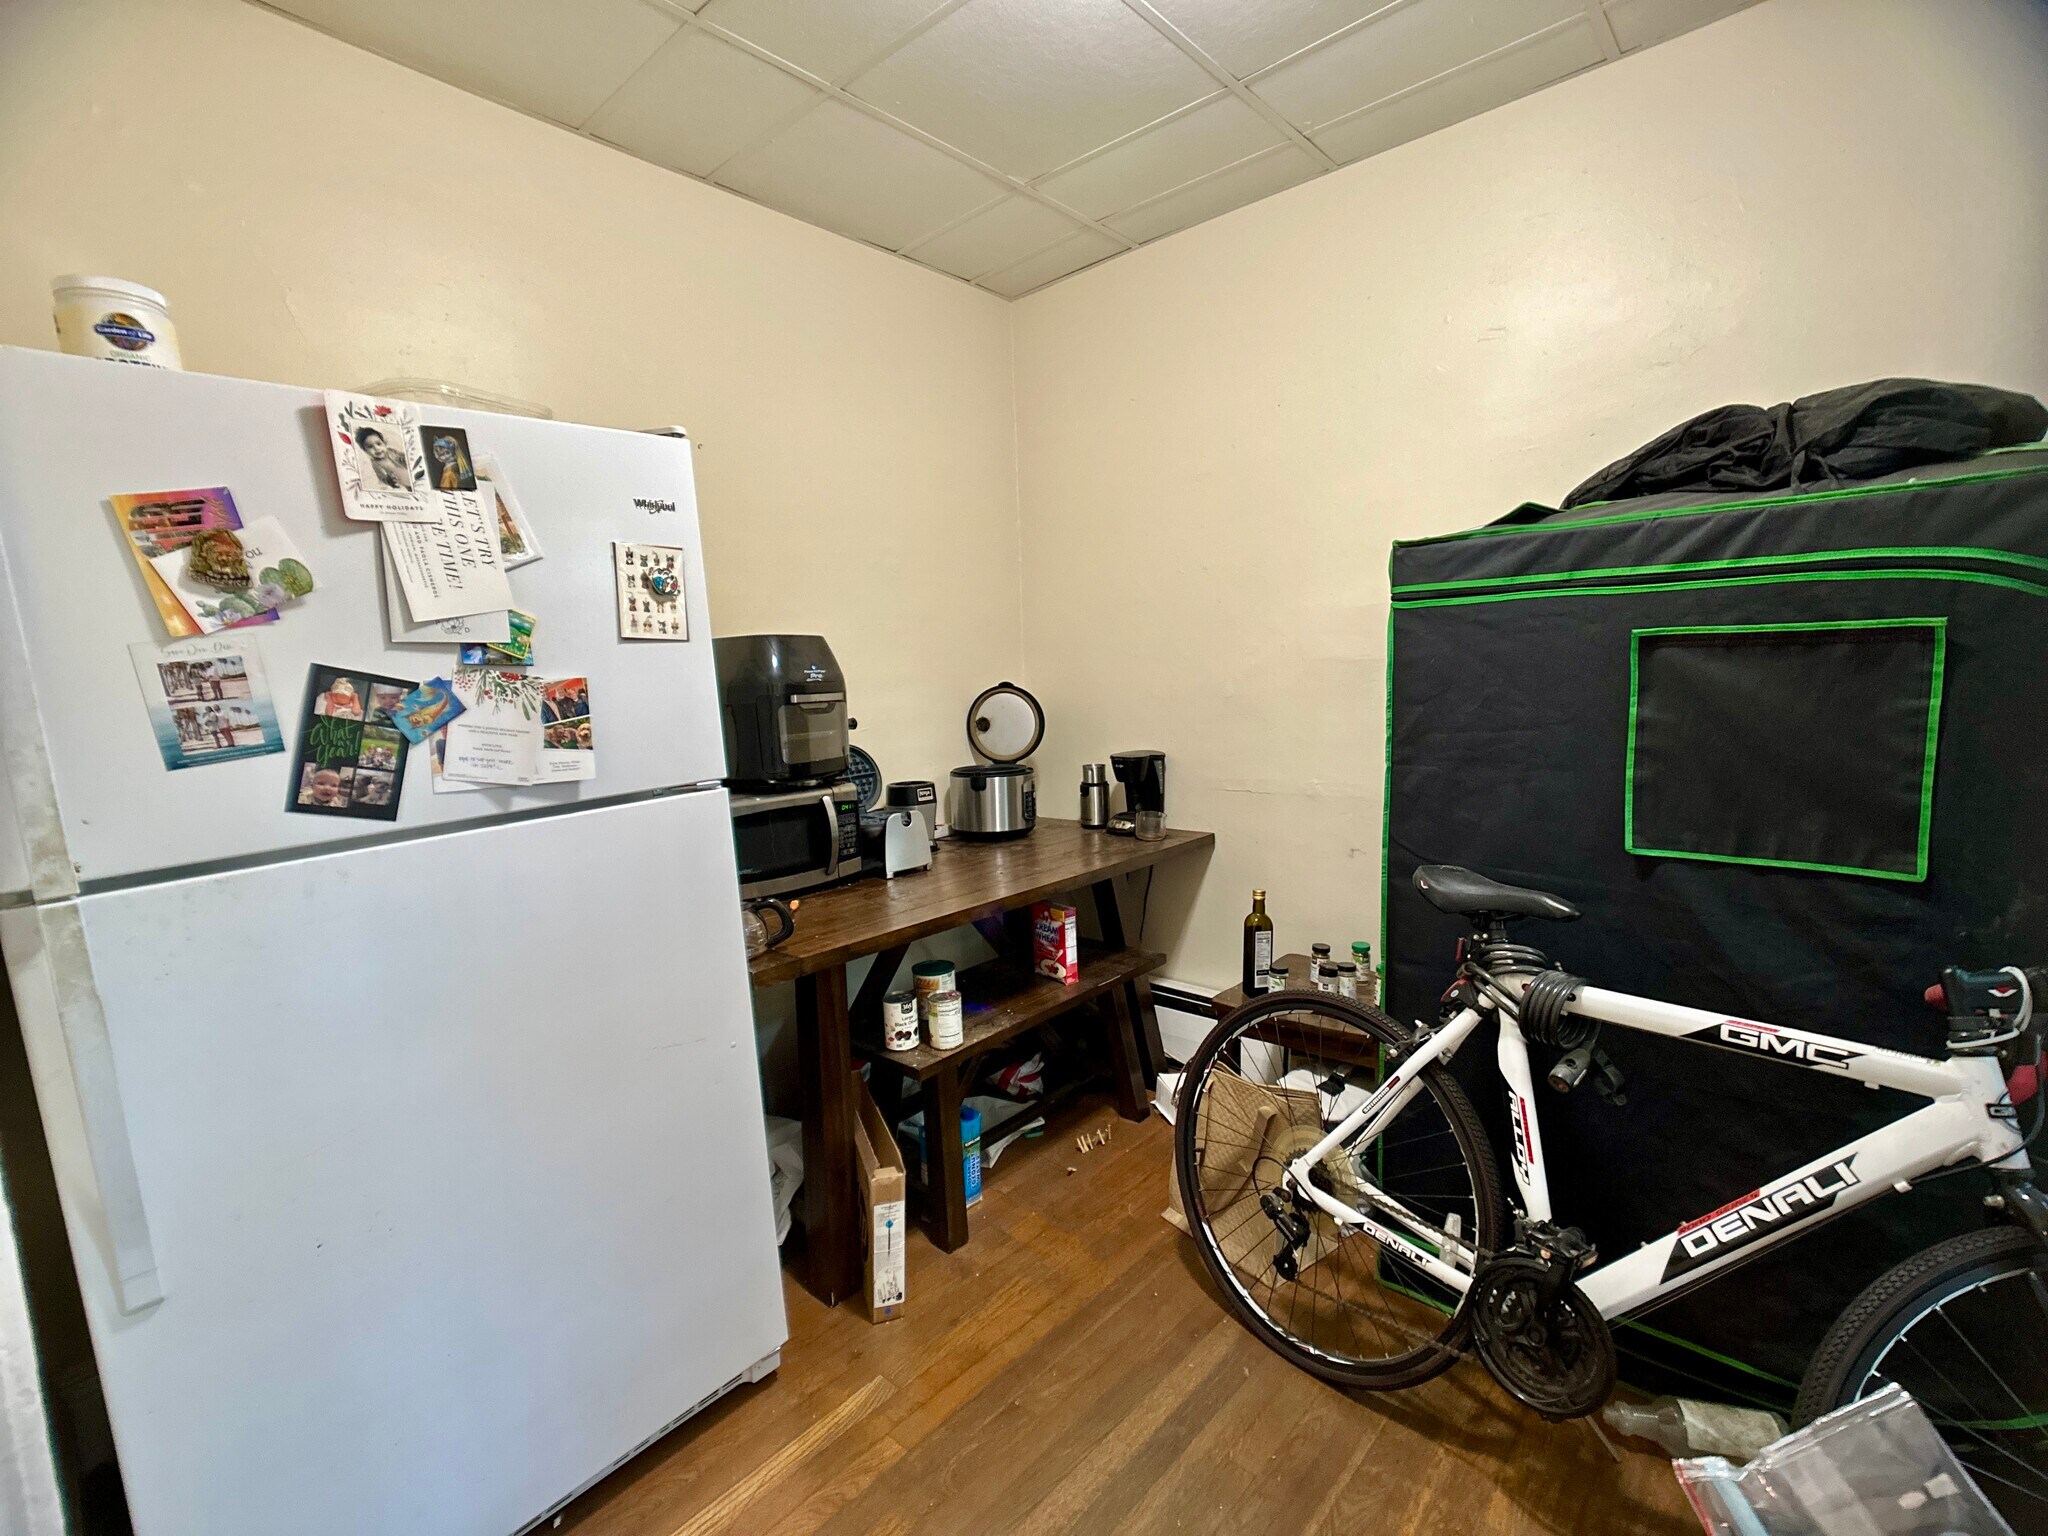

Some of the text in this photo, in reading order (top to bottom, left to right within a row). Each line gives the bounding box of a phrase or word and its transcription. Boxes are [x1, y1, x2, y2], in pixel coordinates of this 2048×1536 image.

[632, 498, 676, 515] Whirlpool
[440, 489, 477, 569] THIS ONE
[245, 547, 263, 558] ou
[436, 540, 463, 590] TIME!
[475, 536, 497, 571] TRY
[309, 716, 354, 746] What
[1035, 921, 1059, 935] CREAM
[1035, 930, 1059, 945] WHEAT
[1719, 1022, 1850, 1070] GMC
[1363, 1087, 1390, 1114] SHIMANO
[1507, 1090, 1531, 1186] ALLOY
[1679, 1161, 1862, 1259] DENALI
[1362, 1222, 1431, 1268] DENALI
